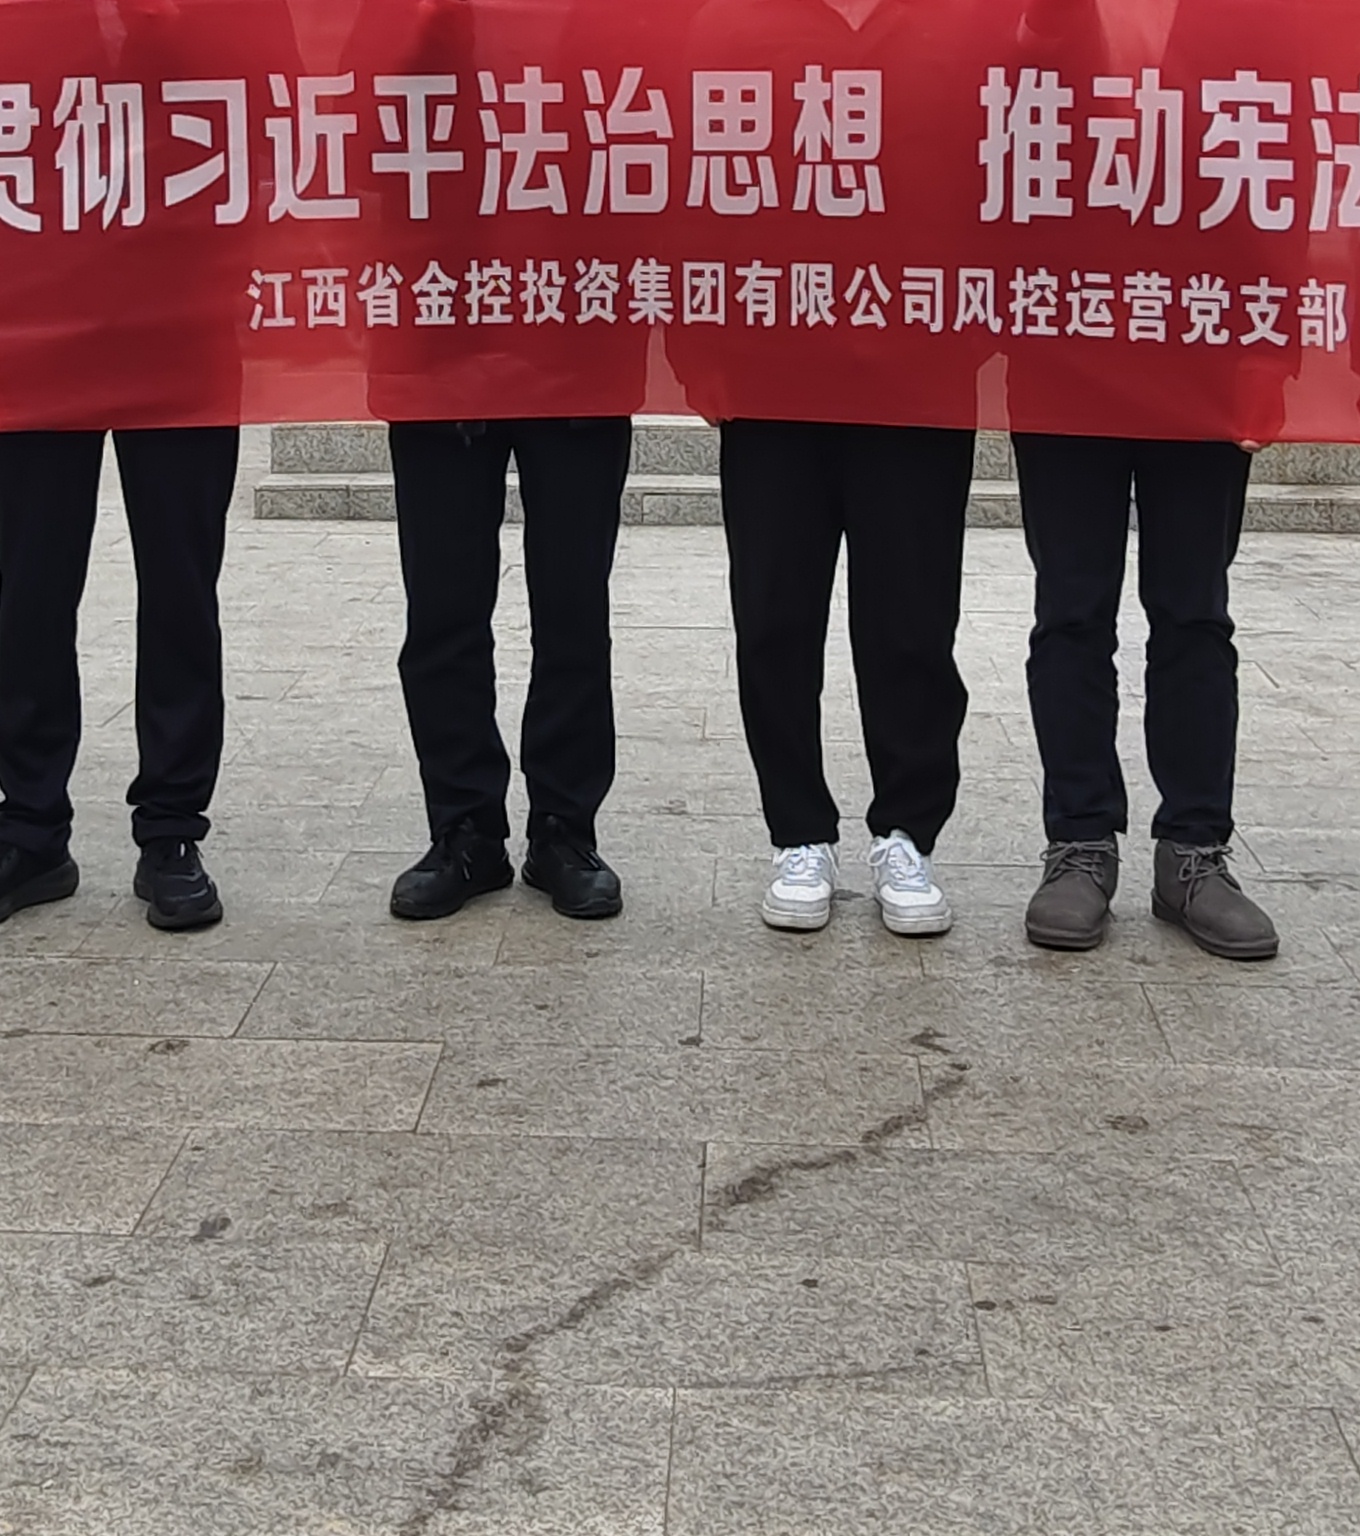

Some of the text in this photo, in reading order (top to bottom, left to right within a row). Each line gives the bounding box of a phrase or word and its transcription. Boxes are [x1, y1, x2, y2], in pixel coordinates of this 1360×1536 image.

[246, 257, 1348, 353] 江西省金控投资集团有限公司风控运营党支部
